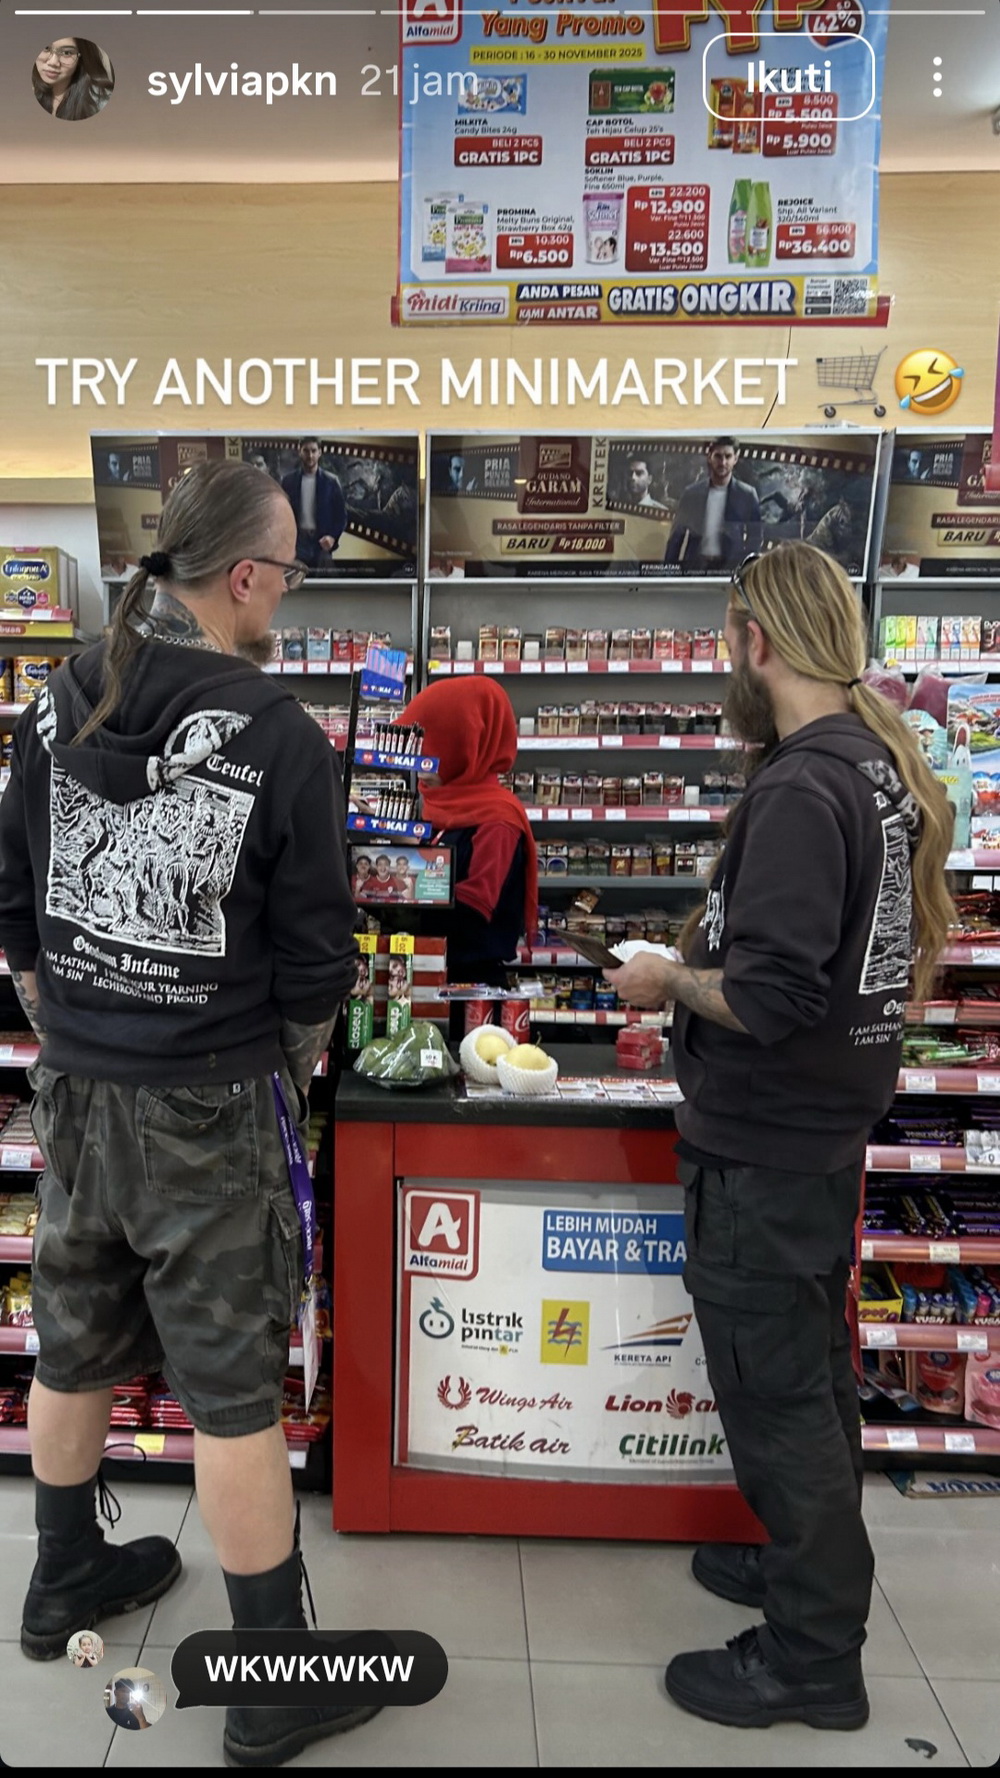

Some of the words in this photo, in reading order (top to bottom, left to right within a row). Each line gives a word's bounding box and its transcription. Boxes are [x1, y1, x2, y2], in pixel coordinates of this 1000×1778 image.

[480, 10, 548, 42] Yang
[557, 12, 644, 38] Promo
[813, 11, 856, 33] 42%
[406, 25, 454, 37] Alfamidi
[473, 51, 517, 60] PERIODE
[526, 51, 535, 60] 16
[544, 50, 556, 59] 30
[559, 49, 616, 59] NOVEMBER
[620, 48, 642, 57] 2025
[586, 119, 604, 127] CAP
[606, 118, 634, 126] BOTOL
[785, 109, 833, 123] 5.500
[455, 127, 479, 135] Candy
[492, 139, 511, 148] BELI
[521, 139, 539, 147] PCS
[624, 139, 643, 148] BELI
[653, 138, 671, 147] PCS
[783, 134, 832, 148] 5.900
[459, 152, 510, 164] GRATIS
[513, 151, 539, 163] 1PC
[590, 152, 642, 164] GRATIS
[645, 151, 671, 163] 1PC
[670, 187, 706, 196] 22.200
[634, 201, 648, 211] Rp
[650, 200, 705, 214] 12.900
[778, 198, 814, 207] REJOICE
[809, 206, 837, 214] Variant
[496, 224, 539, 233] Strawberry
[634, 243, 647, 252] Rp
[649, 242, 704, 256] 13.500
[519, 286, 559, 299] ANDA
[562, 285, 600, 298] PESAN
[608, 286, 677, 311] GRATIS
[681, 281, 793, 311] ONGKIR
[408, 291, 458, 311] midi
[459, 299, 501, 313] Kriing
[519, 308, 544, 319] KAMI
[547, 307, 598, 319] ANTAR
[484, 458, 510, 470] PRIA
[537, 473, 571, 481] GUDANG
[593, 436, 607, 508] KRETEK
[526, 480, 581, 494] GARAM
[525, 497, 581, 507] International
[519, 522, 567, 530] LEGENDARIS
[568, 522, 593, 530] TANPA
[594, 521, 620, 530] FILTER
[957, 516, 1000, 524] LEGENDARI
[944, 531, 985, 541] BARU
[506, 538, 550, 549] BARU
[378, 754, 415, 767] TOKAI
[205, 753, 264, 787] Teufel
[370, 819, 407, 832] TOKAI
[60, 954, 98, 973] SATHAN
[120, 953, 180, 978] Infame
[66, 969, 84, 982] SIN
[158, 982, 219, 994] YEARNING
[166, 994, 208, 1005] PROUD
[351, 1006, 364, 1049] closeup
[855, 1025, 870, 1036] AM
[859, 1036, 874, 1046] AM
[875, 1033, 891, 1044] SIN
[546, 1214, 591, 1233] LEBIH
[595, 1217, 657, 1235] MUDAH
[546, 1236, 619, 1261] BAYAR
[624, 1239, 642, 1262] &
[410, 1254, 468, 1271] Alfamidi
[461, 1308, 523, 1328] listrik
[461, 1326, 523, 1342] pintar
[614, 1354, 652, 1362] KERETA
[655, 1355, 672, 1363] API
[476, 1387, 537, 1412] Wings
[538, 1392, 573, 1410] Air
[605, 1394, 663, 1413] Lion
[452, 1424, 525, 1451] Batik
[529, 1438, 571, 1454] air
[619, 1433, 726, 1458] Citilink
